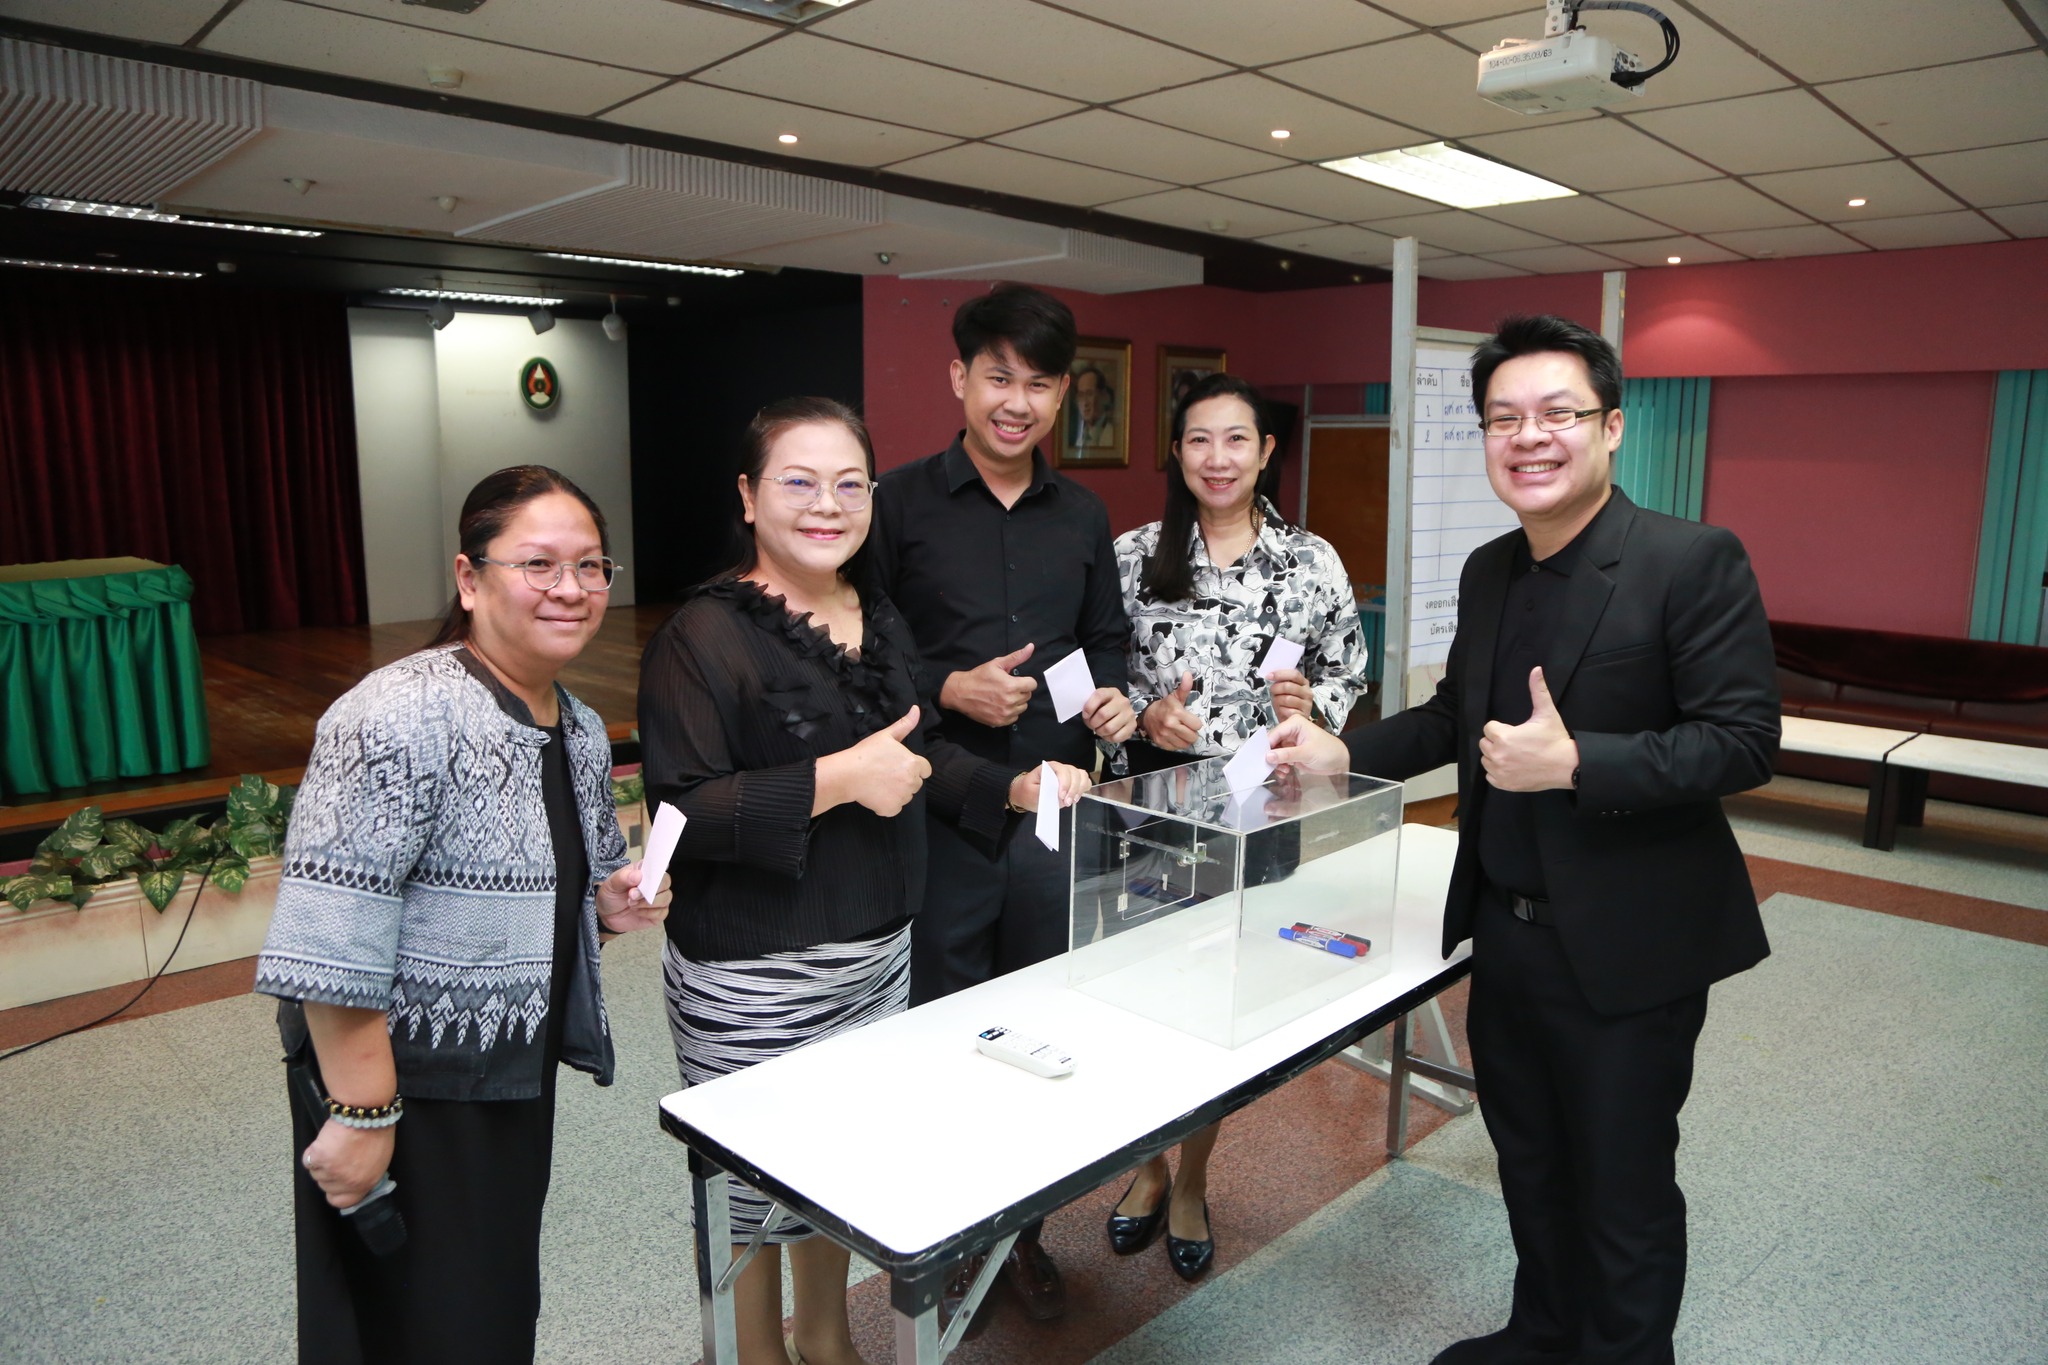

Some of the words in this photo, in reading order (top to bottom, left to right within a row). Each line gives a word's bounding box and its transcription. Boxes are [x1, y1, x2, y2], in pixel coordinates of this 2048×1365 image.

[1416, 373, 1438, 387] ลำดับ
[1460, 372, 1471, 387] ชื่อ
[1426, 404, 1431, 417] 1
[1425, 429, 1430, 443] 2
[1425, 595, 1459, 610] งดออกเสี
